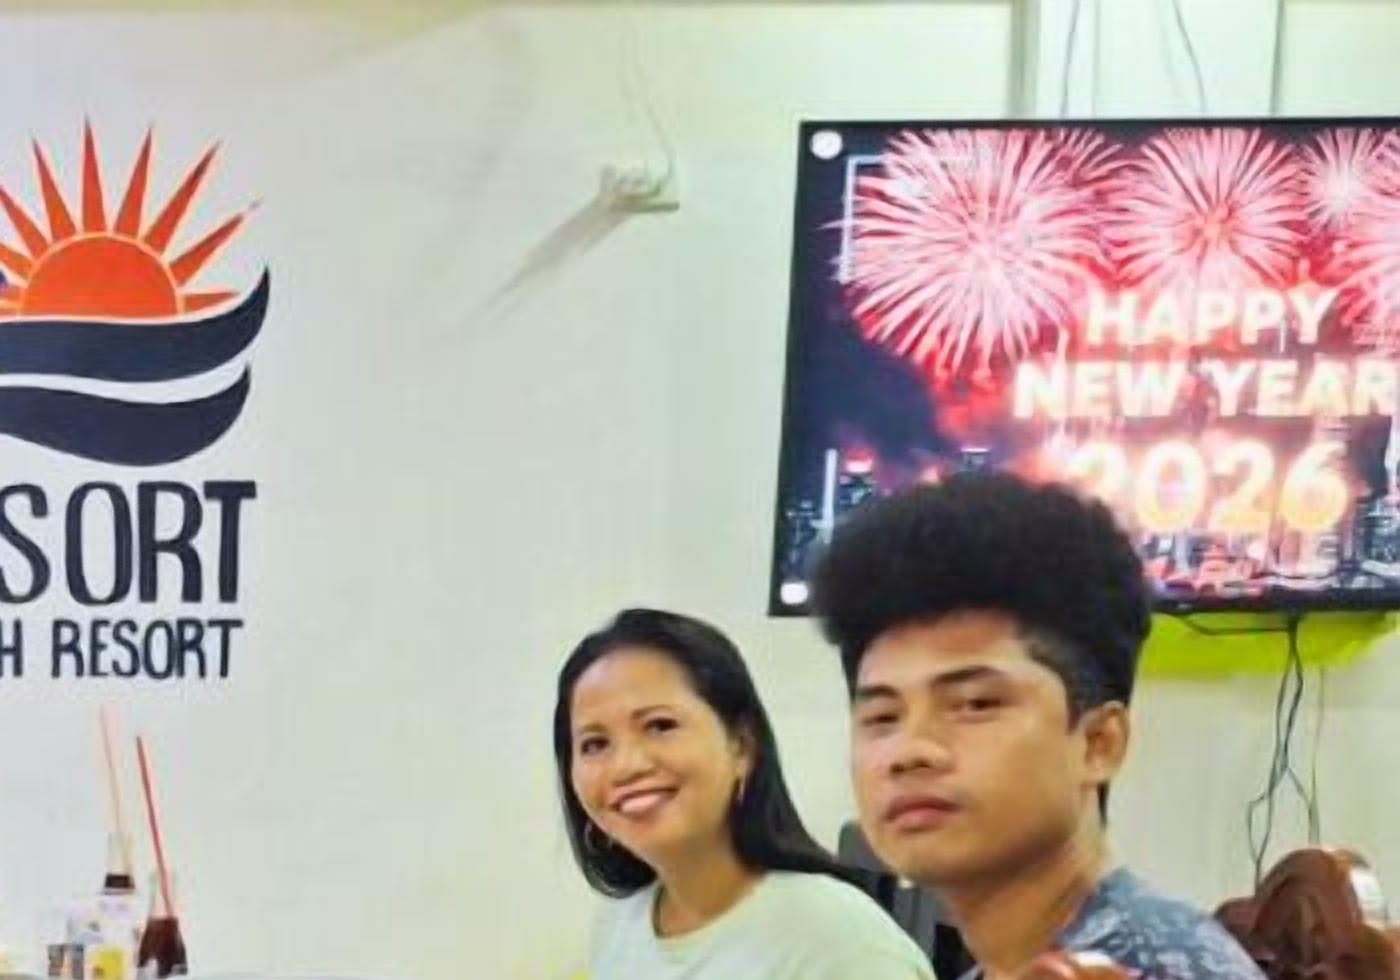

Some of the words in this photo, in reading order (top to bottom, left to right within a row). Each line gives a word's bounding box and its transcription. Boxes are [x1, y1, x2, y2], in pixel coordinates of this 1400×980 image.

[1085, 286, 1338, 345] HAPPY
[1012, 358, 1192, 418] NEW
[1200, 358, 1398, 418] YEAR
[51, 618, 243, 680] RESORT
